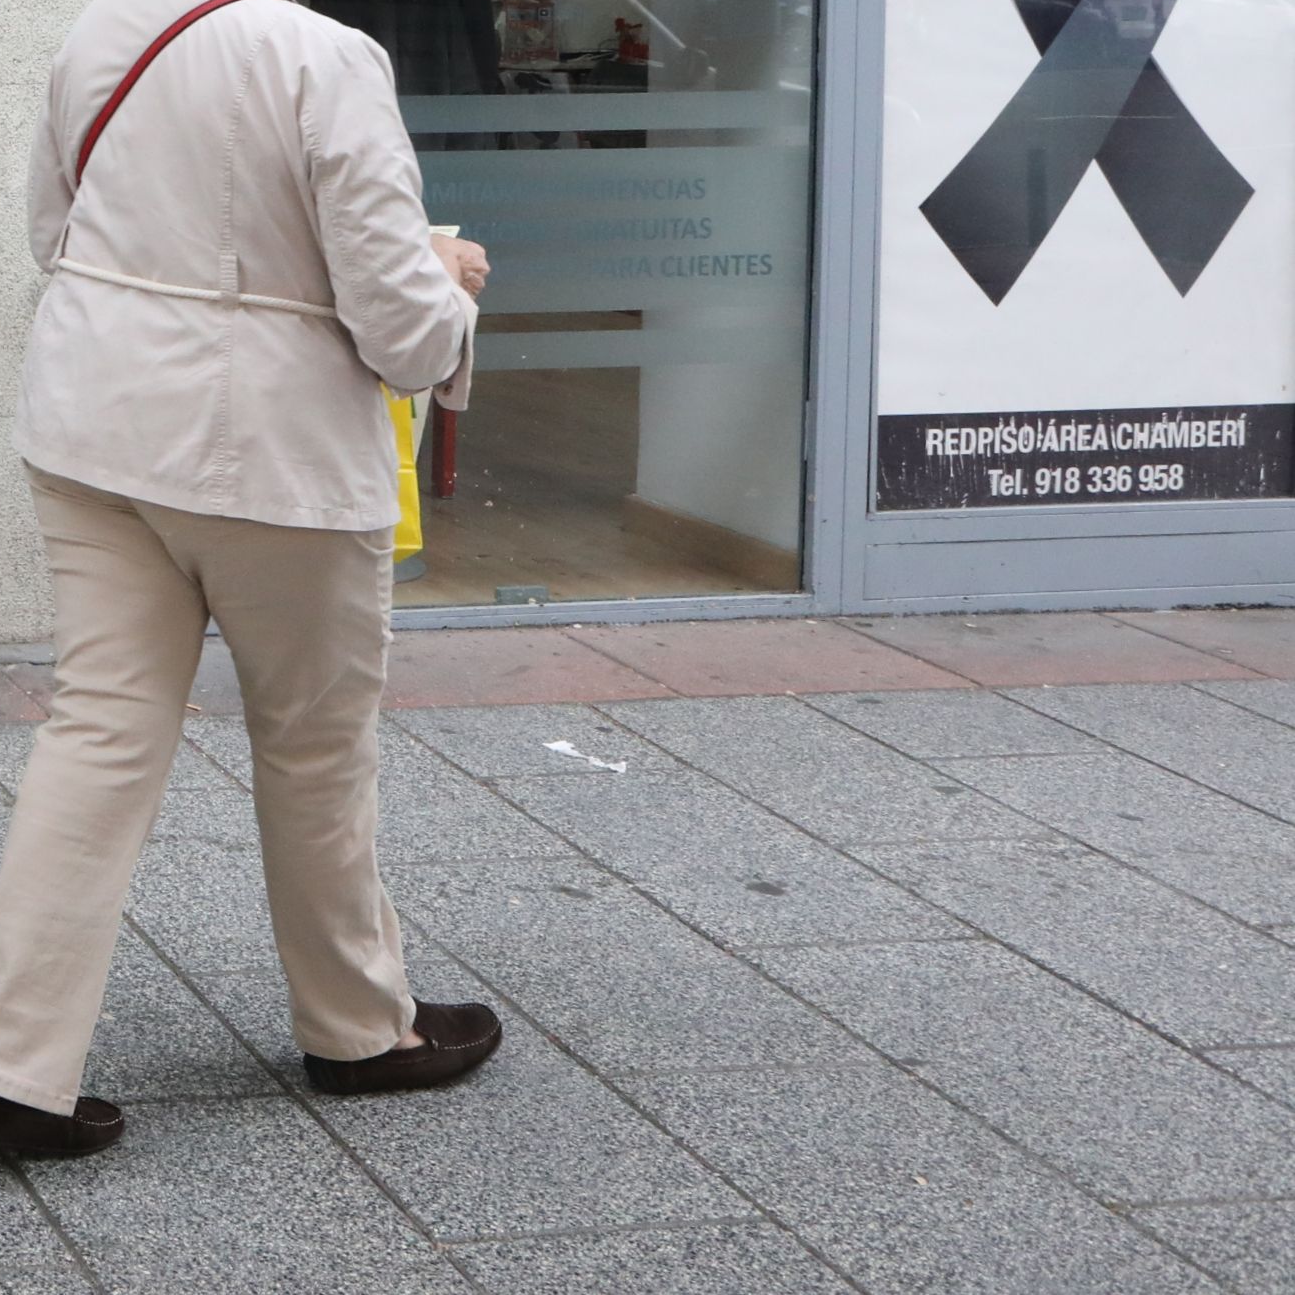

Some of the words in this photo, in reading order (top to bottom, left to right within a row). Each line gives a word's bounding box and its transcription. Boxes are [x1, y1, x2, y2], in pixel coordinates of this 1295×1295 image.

[660, 253, 774, 278] CLIENTES
[926, 426, 1036, 455] REDPISO
[1040, 419, 1109, 453] ÁREA
[1116, 413, 1247, 450] CHAMBERÍ
[988, 468, 1029, 496] Tel.
[1035, 466, 1081, 495] 918
[1086, 464, 1132, 493] 336
[1138, 463, 1184, 492] 958
